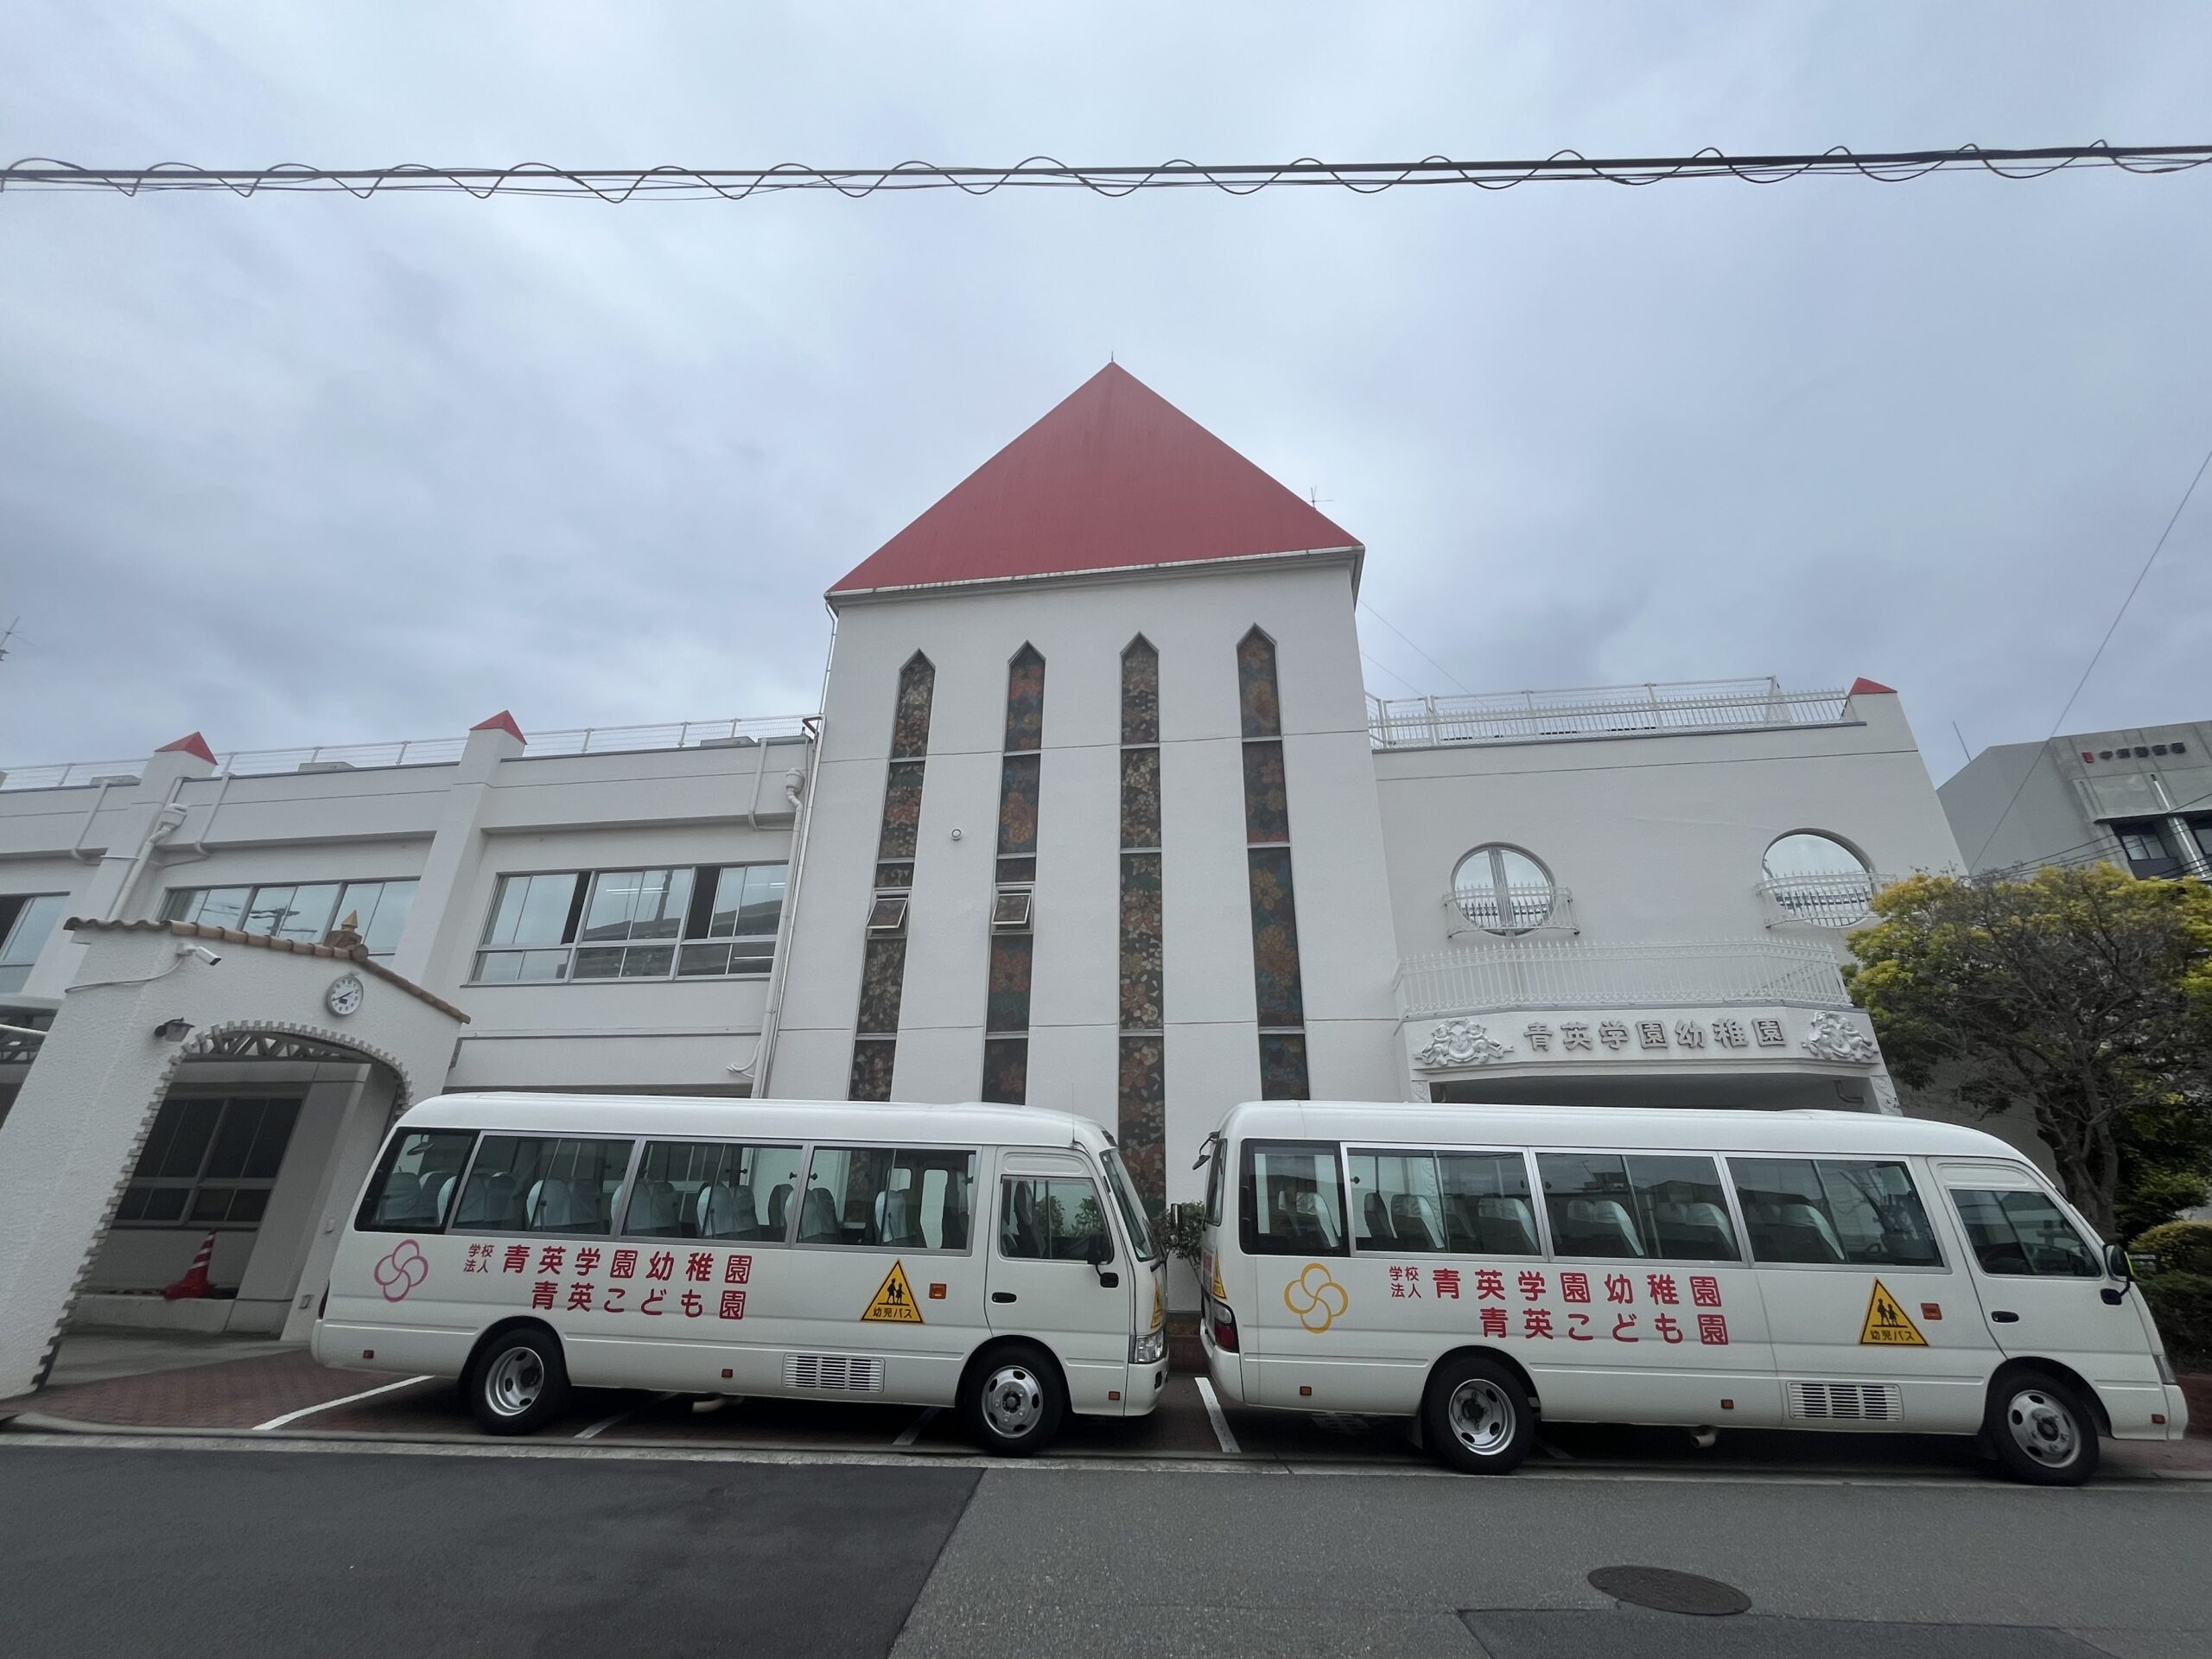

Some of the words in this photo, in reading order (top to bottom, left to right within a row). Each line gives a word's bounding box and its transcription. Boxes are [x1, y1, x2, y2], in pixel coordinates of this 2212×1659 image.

[1523, 1019, 1787, 1051] 青英学園幼稚園
[468, 1243, 494, 1258] 学校
[463, 1259, 489, 1274] 法人
[503, 1244, 752, 1284] 青英学園幼稚園
[1389, 1266, 1419, 1281] 学校
[1390, 1282, 1422, 1299] 法人
[1433, 1268, 1722, 1306] 青英学園幼稚園
[531, 1281, 747, 1320] 青英こども園
[873, 1306, 912, 1319] 幼児バス
[1479, 1307, 1729, 1346] 青英こども園
[1871, 1330, 1915, 1341] 幼児バス
